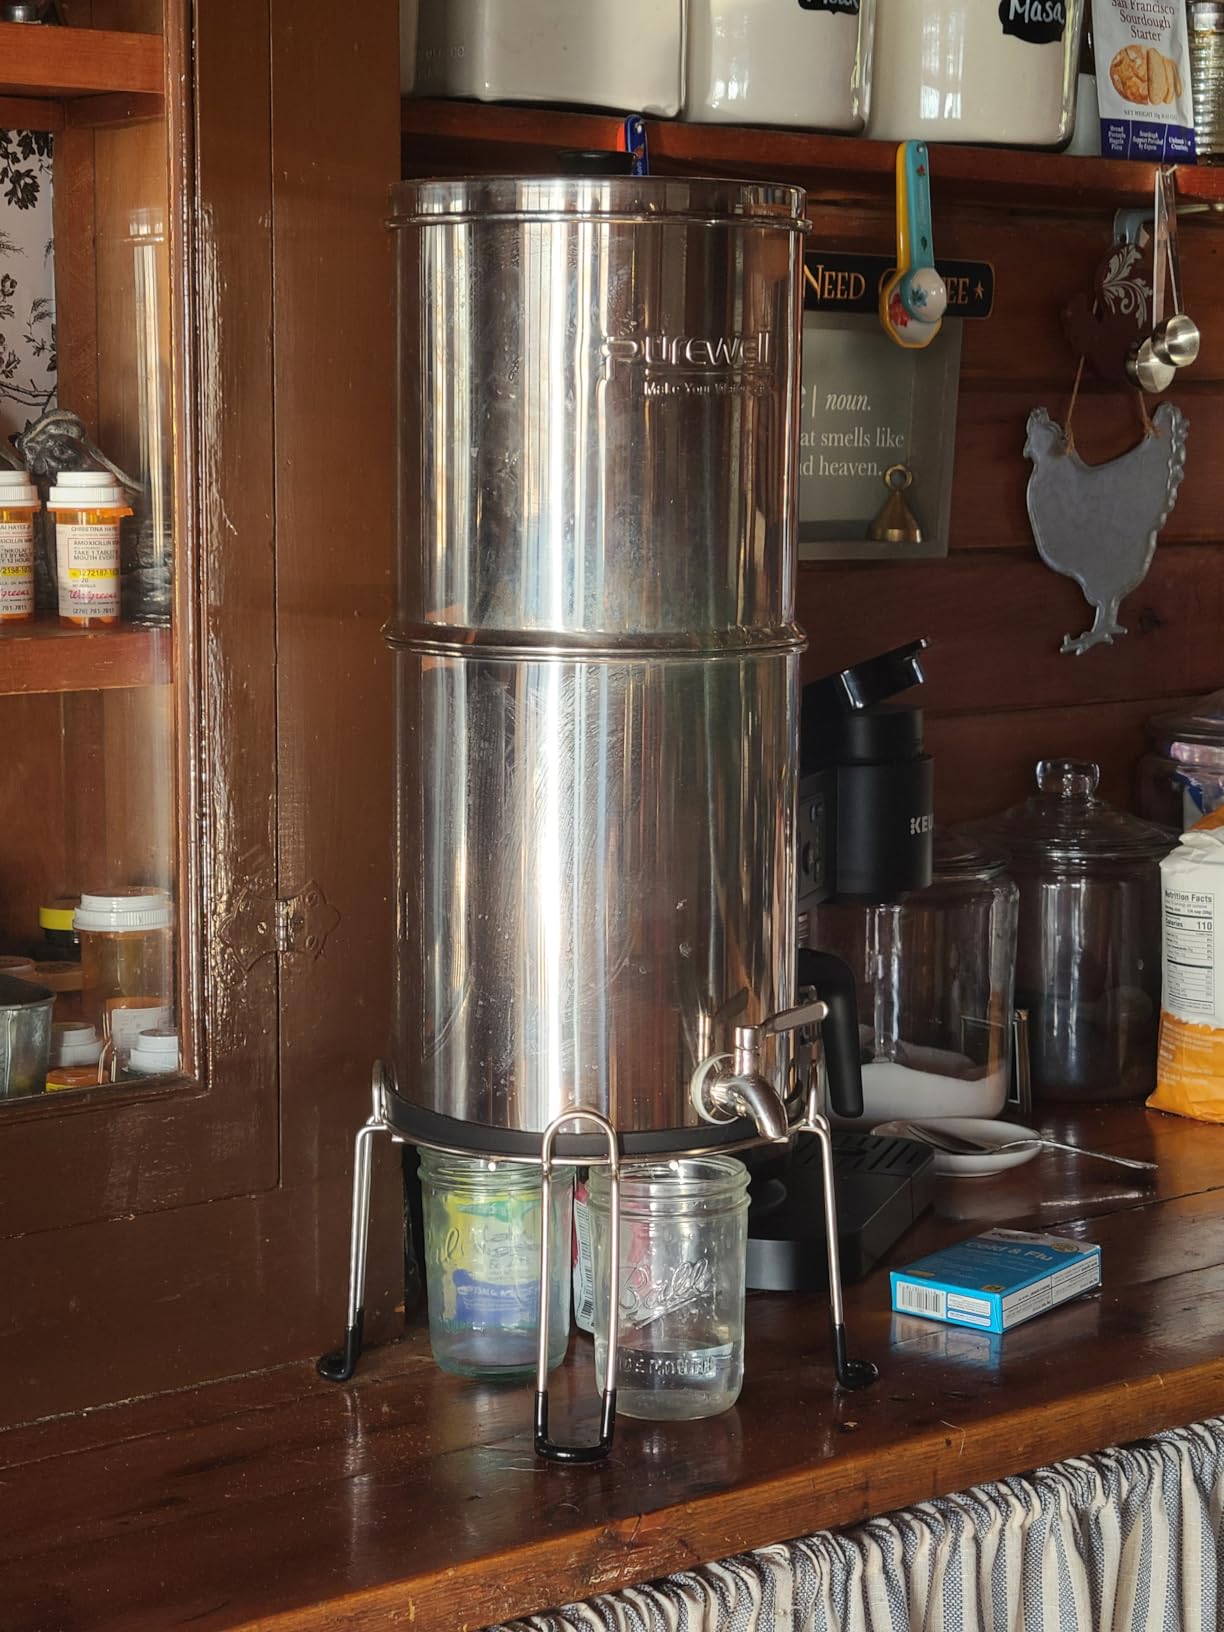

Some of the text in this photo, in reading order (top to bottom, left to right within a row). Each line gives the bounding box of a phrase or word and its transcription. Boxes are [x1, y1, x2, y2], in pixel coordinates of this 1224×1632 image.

[1009, 0, 1064, 24] Masa
[1130, 0, 1175, 15] Francisco
[1120, 9, 1171, 30] Sourdough
[1130, 25, 1162, 41] Starter
[803, 264, 866, 302] NEED
[603, 331, 770, 368] Purewell
[825, 393, 871, 411] noun.
[800, 427, 904, 447] at smells like
[820, 455, 882, 476] heaven.
[69, 590, 119, 602] Walgreens
[1165, 890, 1212, 903] Nutrition Facts
[1197, 921, 1213, 930] 110
